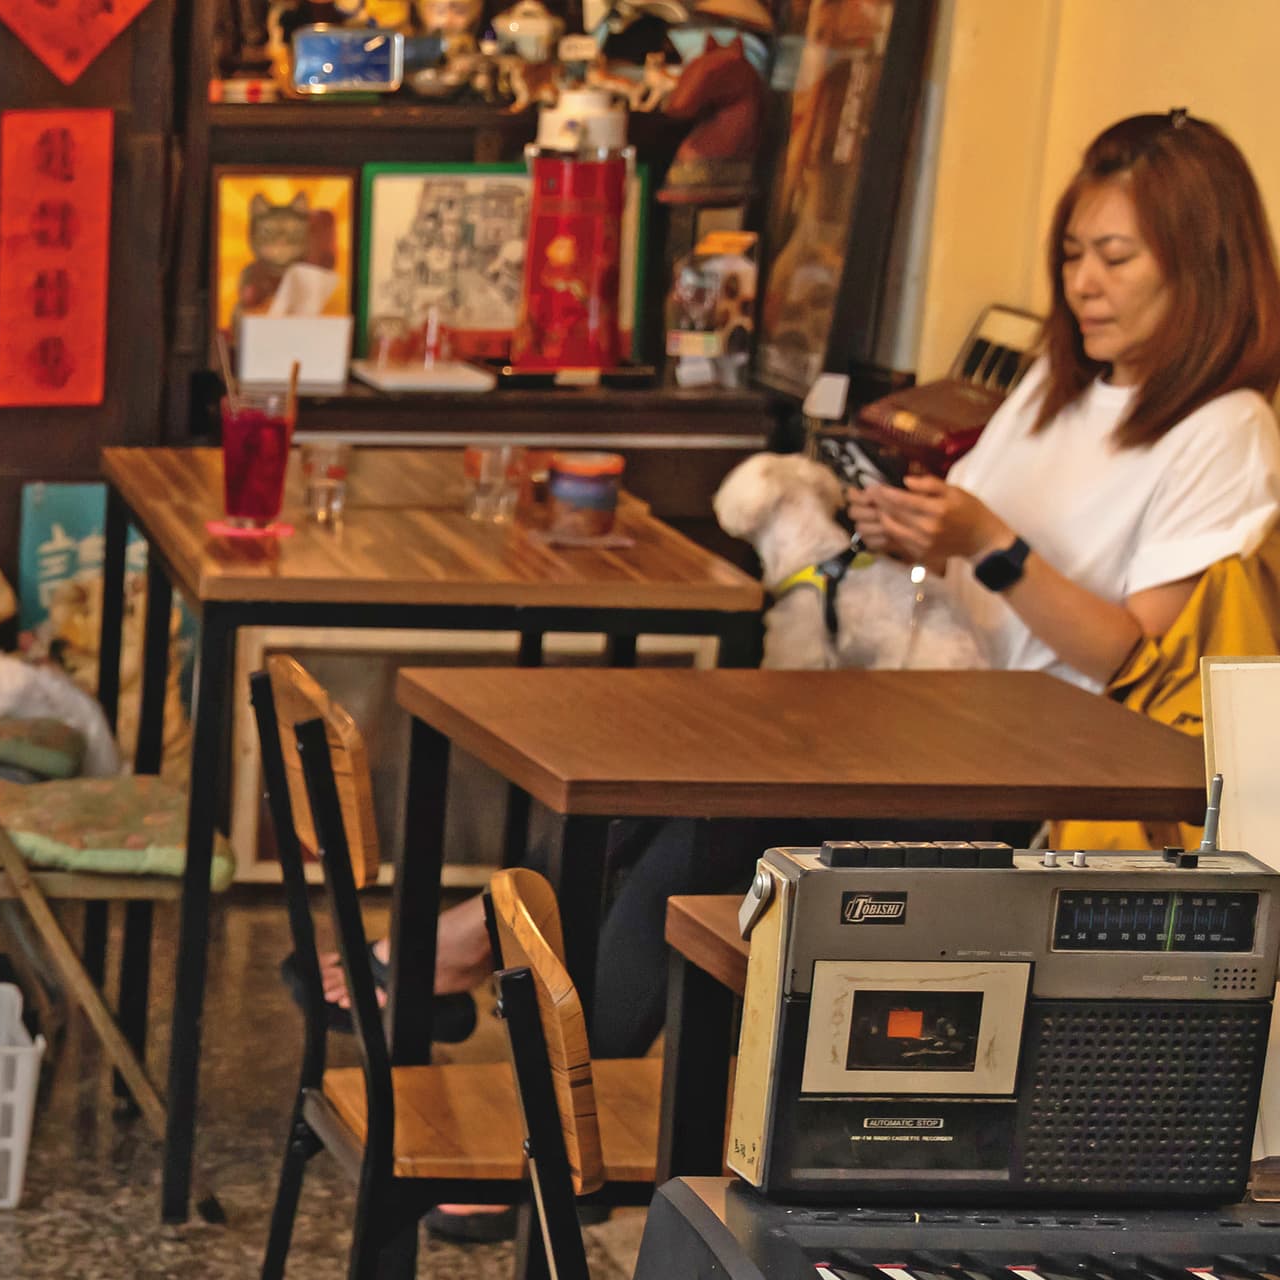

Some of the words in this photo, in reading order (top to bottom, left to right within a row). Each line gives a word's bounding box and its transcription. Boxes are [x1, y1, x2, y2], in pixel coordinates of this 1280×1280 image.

[849, 896, 902, 919] TOBISHI
[1077, 932, 1086, 941] 54
[869, 1119, 913, 1127] AUTOMATIC
[916, 1119, 939, 1127] STOP
